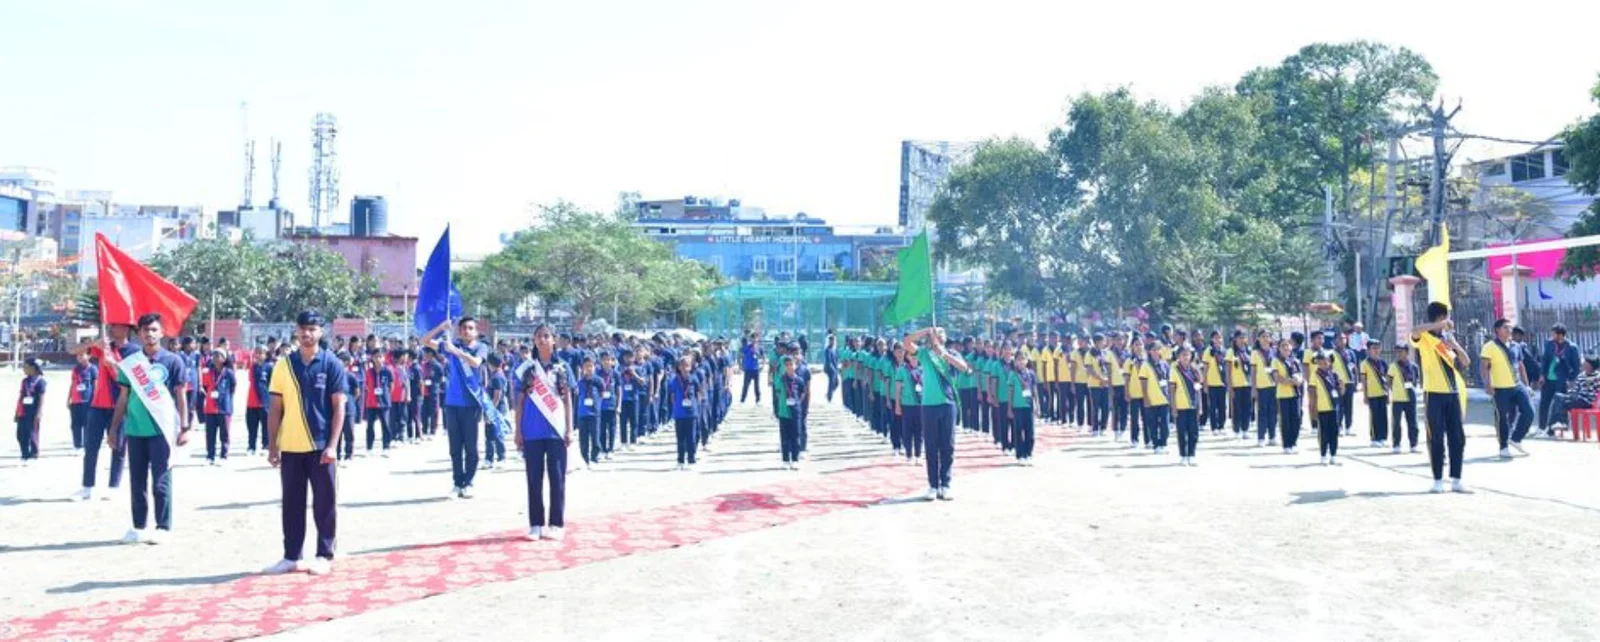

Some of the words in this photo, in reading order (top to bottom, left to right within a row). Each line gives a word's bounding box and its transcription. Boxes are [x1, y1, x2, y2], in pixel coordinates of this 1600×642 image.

[715, 235, 741, 244] LITTLE
[744, 235, 770, 244] HEART
[773, 235, 813, 245] HOSPITAL
